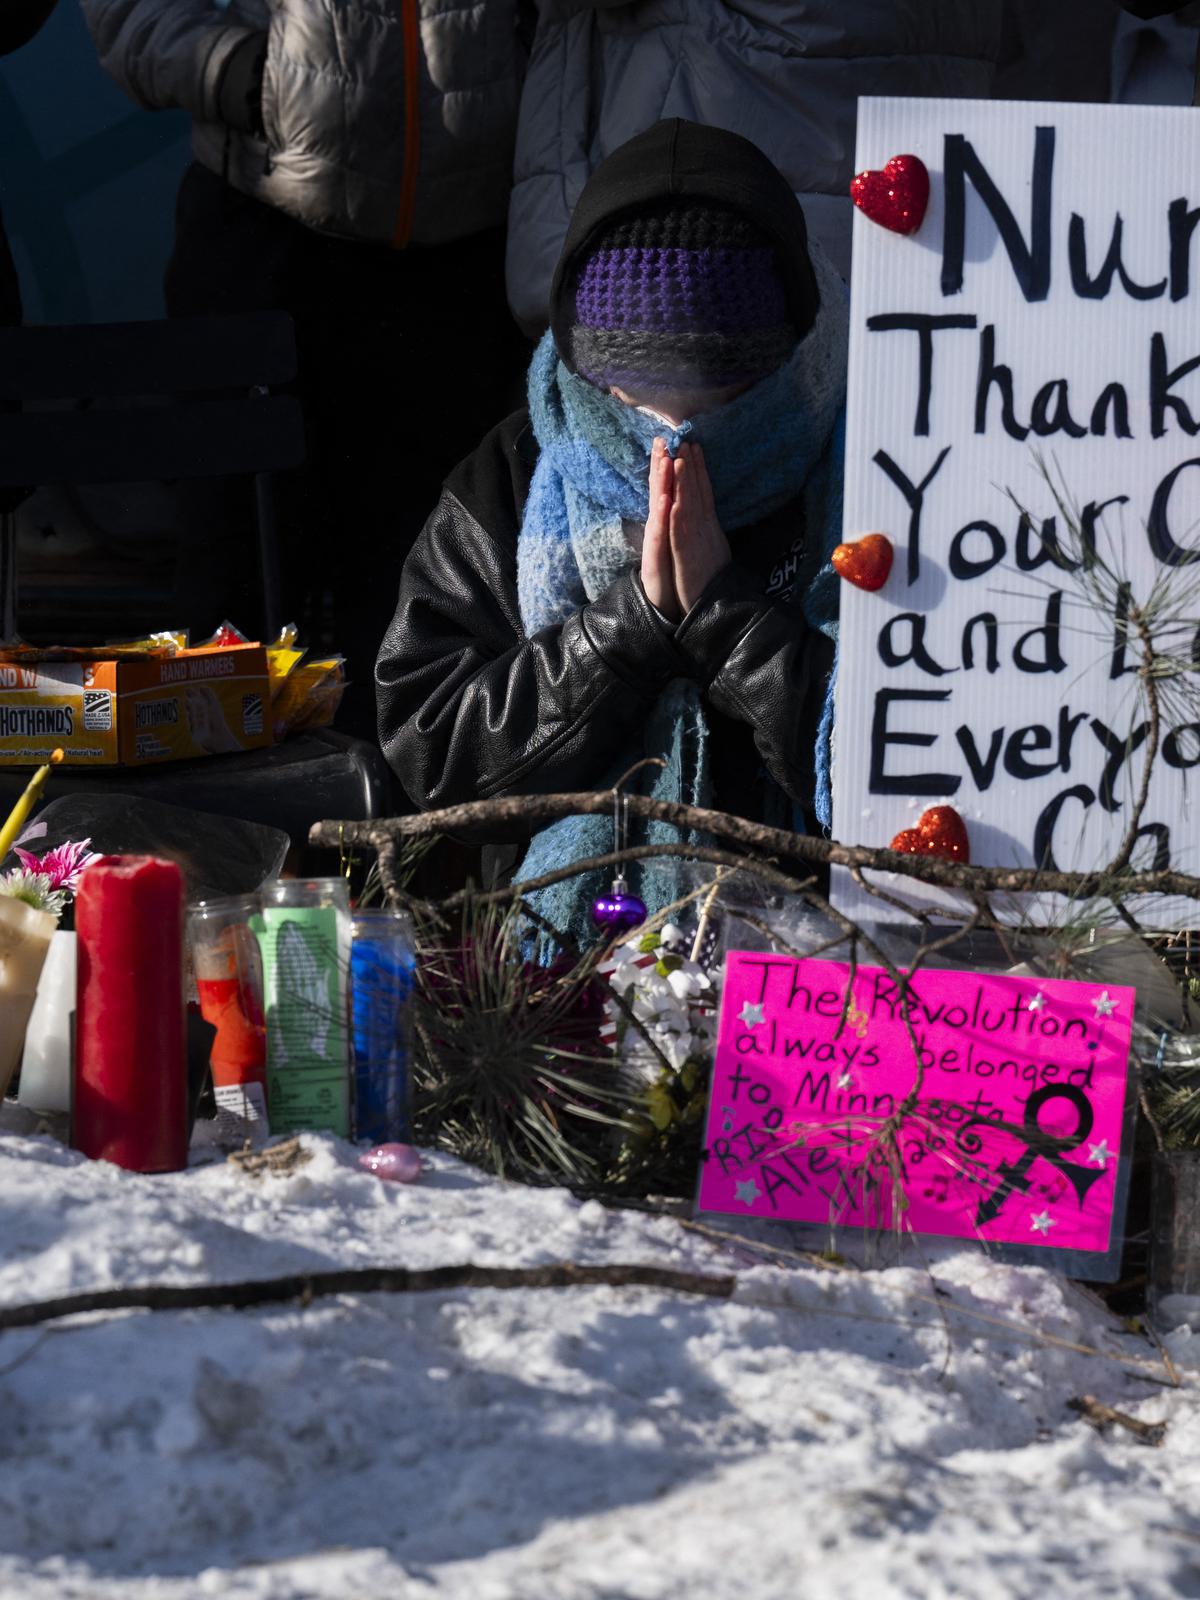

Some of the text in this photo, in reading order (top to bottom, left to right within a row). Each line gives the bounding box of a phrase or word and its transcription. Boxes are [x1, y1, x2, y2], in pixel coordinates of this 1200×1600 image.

[872, 445, 1130, 587] Your
[160, 656, 235, 682] HAND WARMERS
[877, 590, 1067, 677] and
[740, 960, 842, 1016] The
[728, 1063, 772, 1104] to
[735, 1020, 1094, 1104] always belonged
[712, 1107, 784, 1176] RIP
[760, 1119, 864, 1210] Alex
